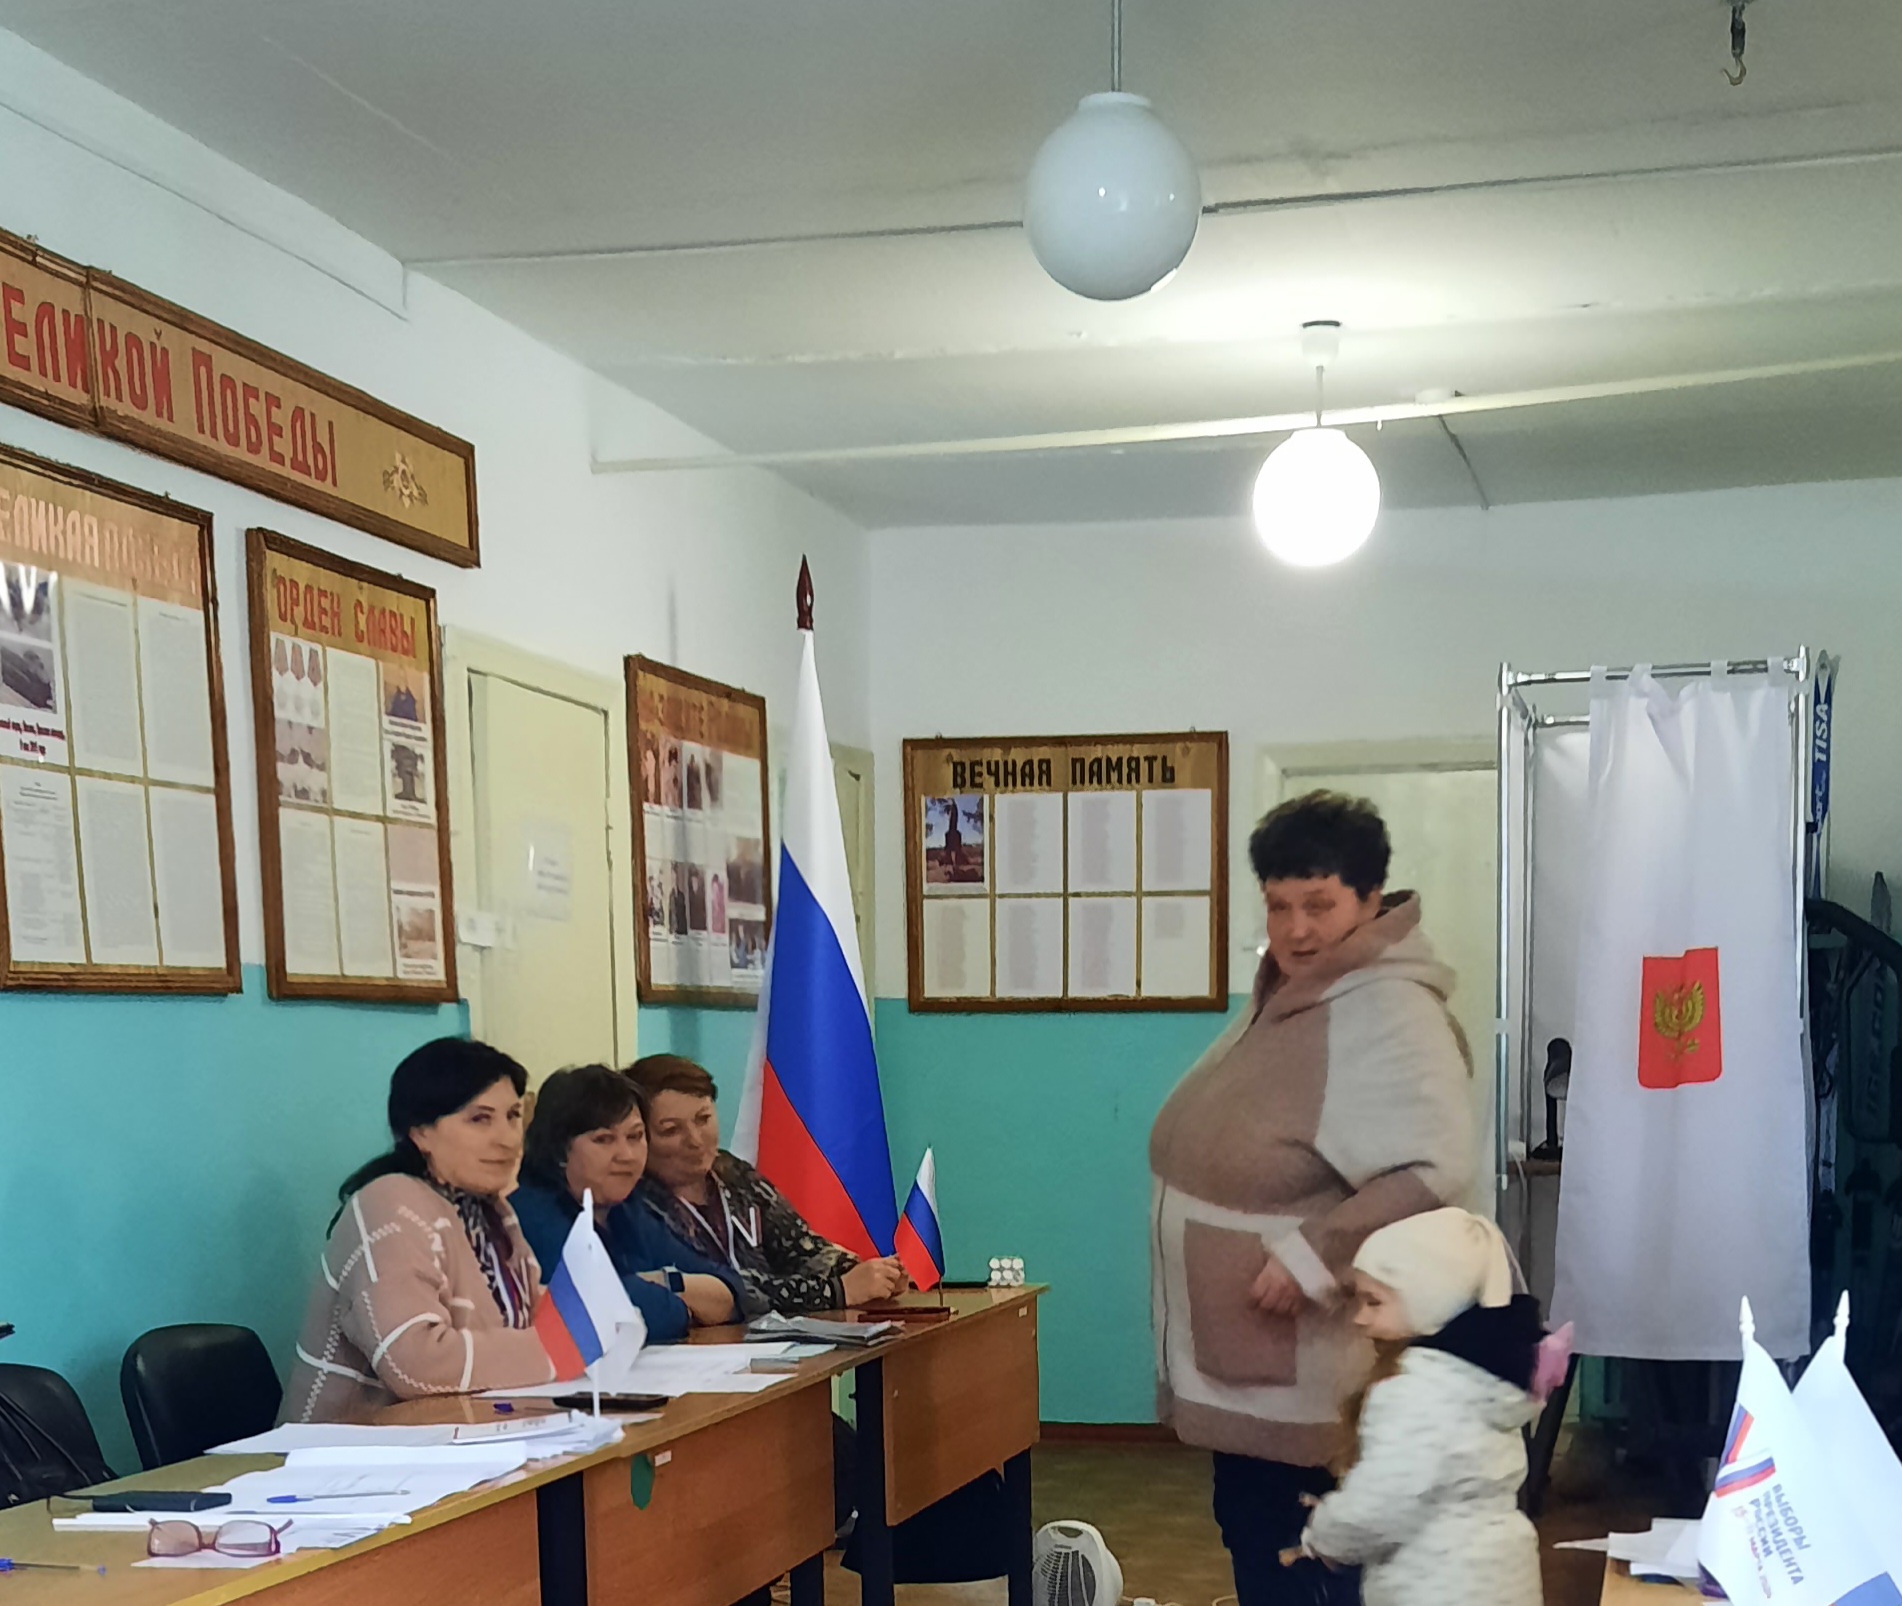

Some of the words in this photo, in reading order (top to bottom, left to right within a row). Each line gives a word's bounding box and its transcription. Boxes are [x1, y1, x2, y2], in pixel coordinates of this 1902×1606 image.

[192, 346, 338, 488] ПОБЕДЫ
[275, 575, 343, 638] ОРДЕН
[353, 598, 417, 659] СЛАВЫ
[1814, 702, 1829, 763] TISA
[952, 757, 1052, 789] ВЕЧНАЯ
[1070, 754, 1176, 787] ПАМЯТЬ
[1762, 1490, 1805, 1585] ПРЕЗИДЕНТА
[1771, 1483, 1812, 1550] ВЫБОРЫ
